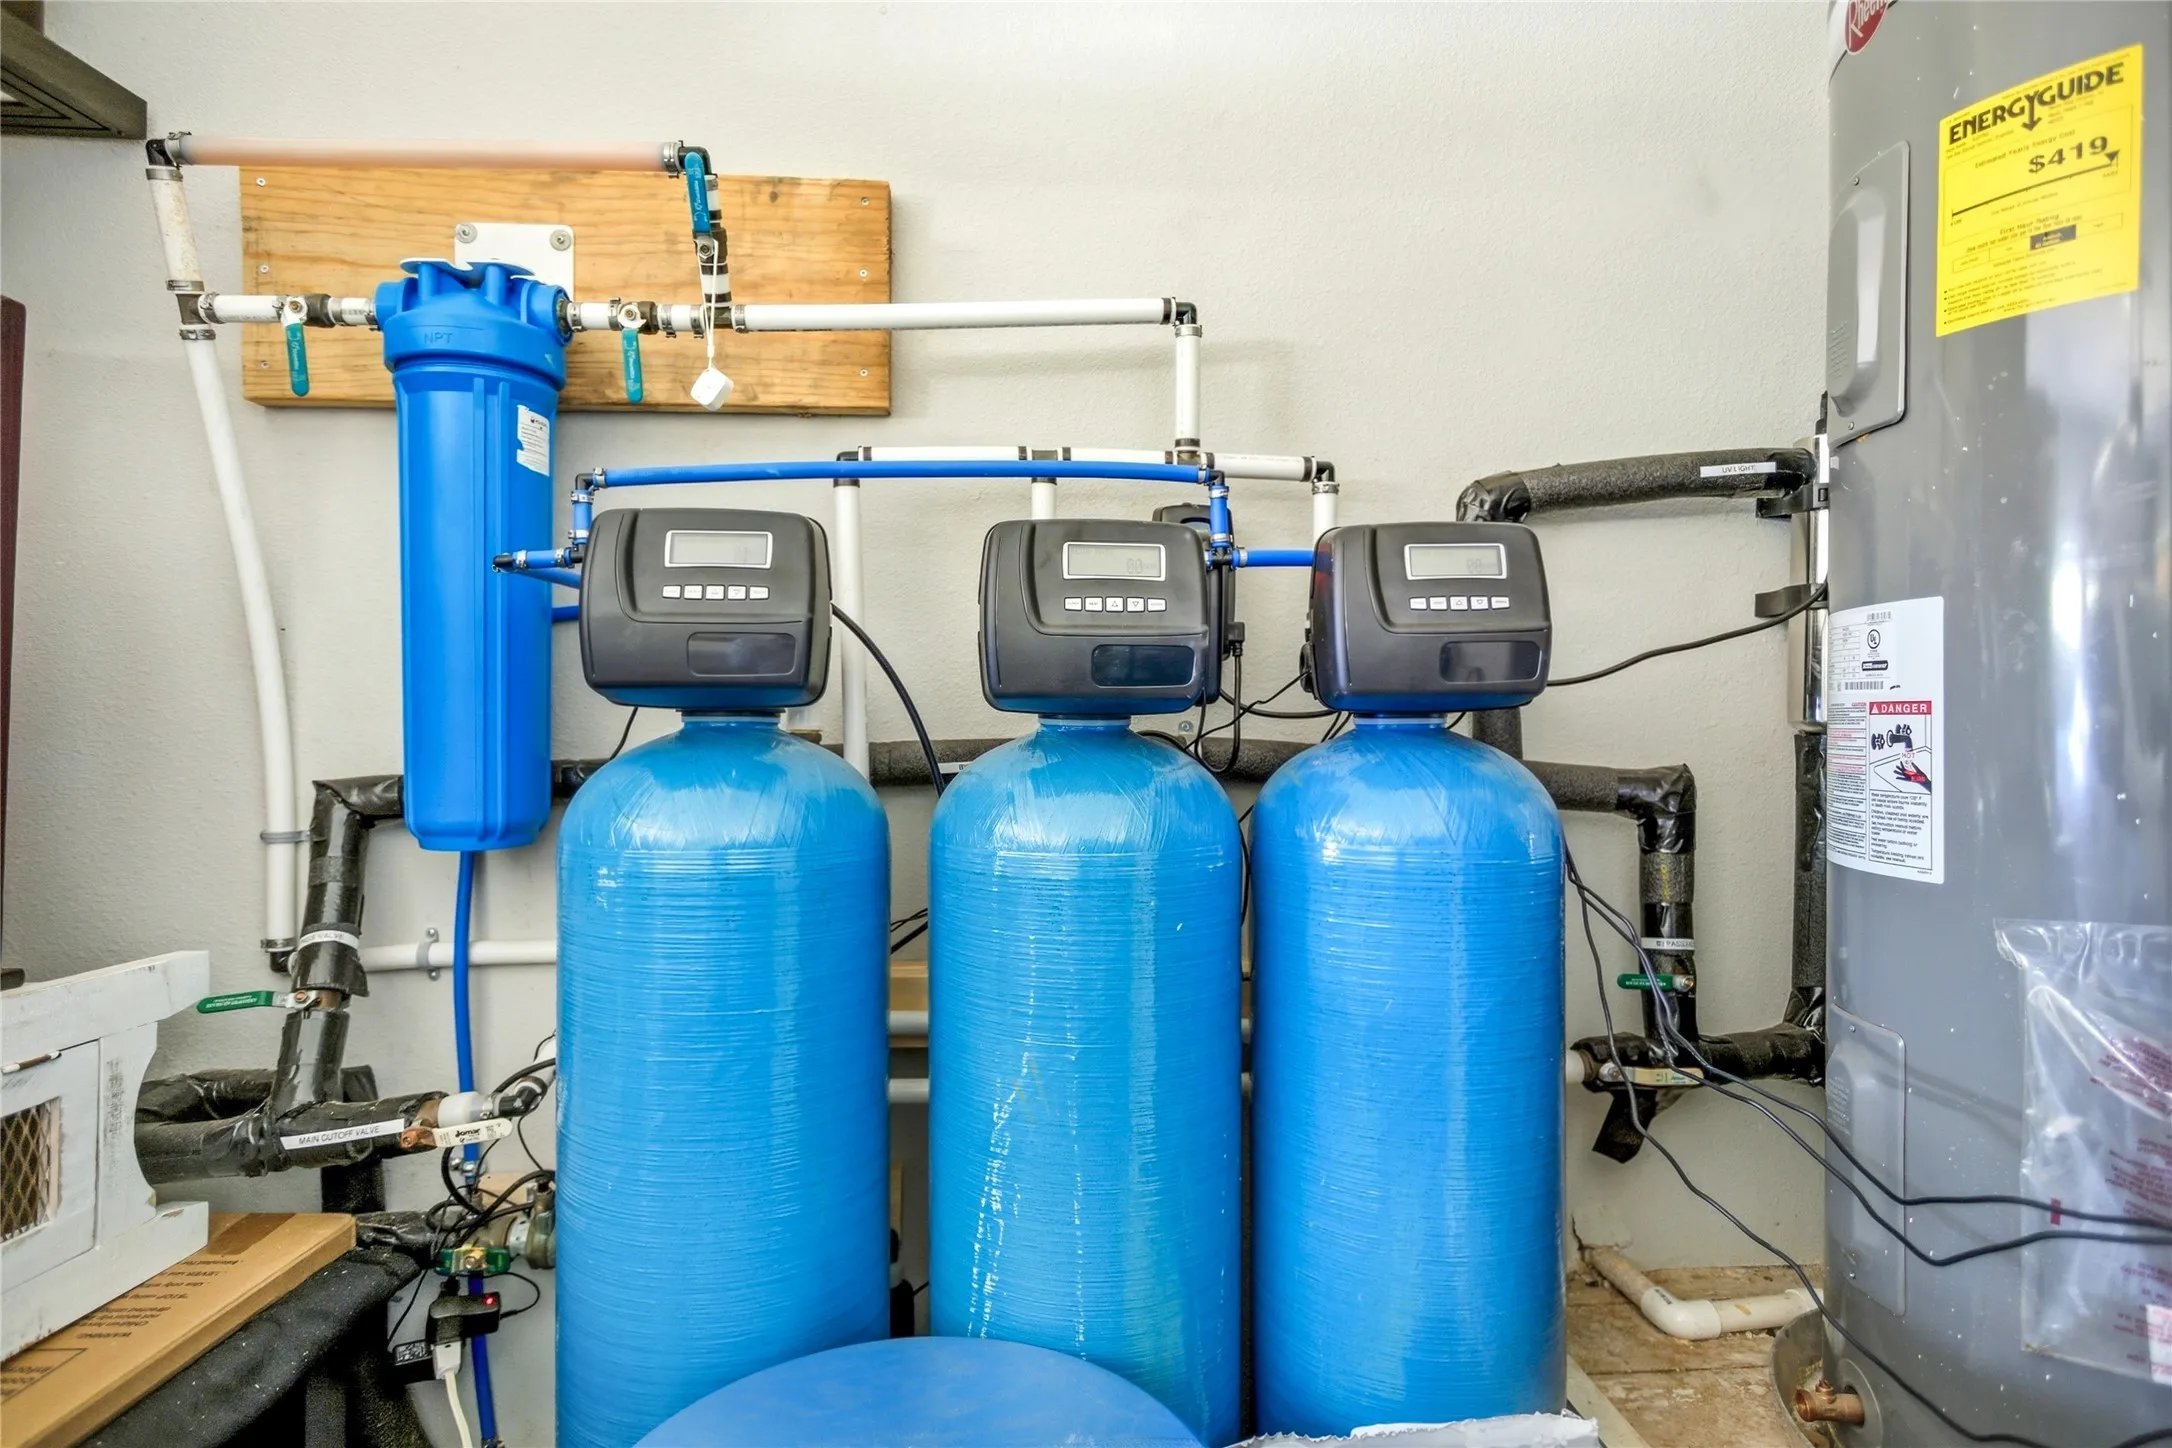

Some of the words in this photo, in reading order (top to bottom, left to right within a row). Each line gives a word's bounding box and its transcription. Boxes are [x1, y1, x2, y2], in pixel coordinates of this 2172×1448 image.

[2028, 136, 2108, 174] $419
[423, 332, 453, 344] NPT
[1881, 703, 1928, 714] DANGER
[299, 1135, 319, 1145] MAIN
[322, 1131, 353, 1143] CUTOFF
[356, 1125, 380, 1136] VALVE
